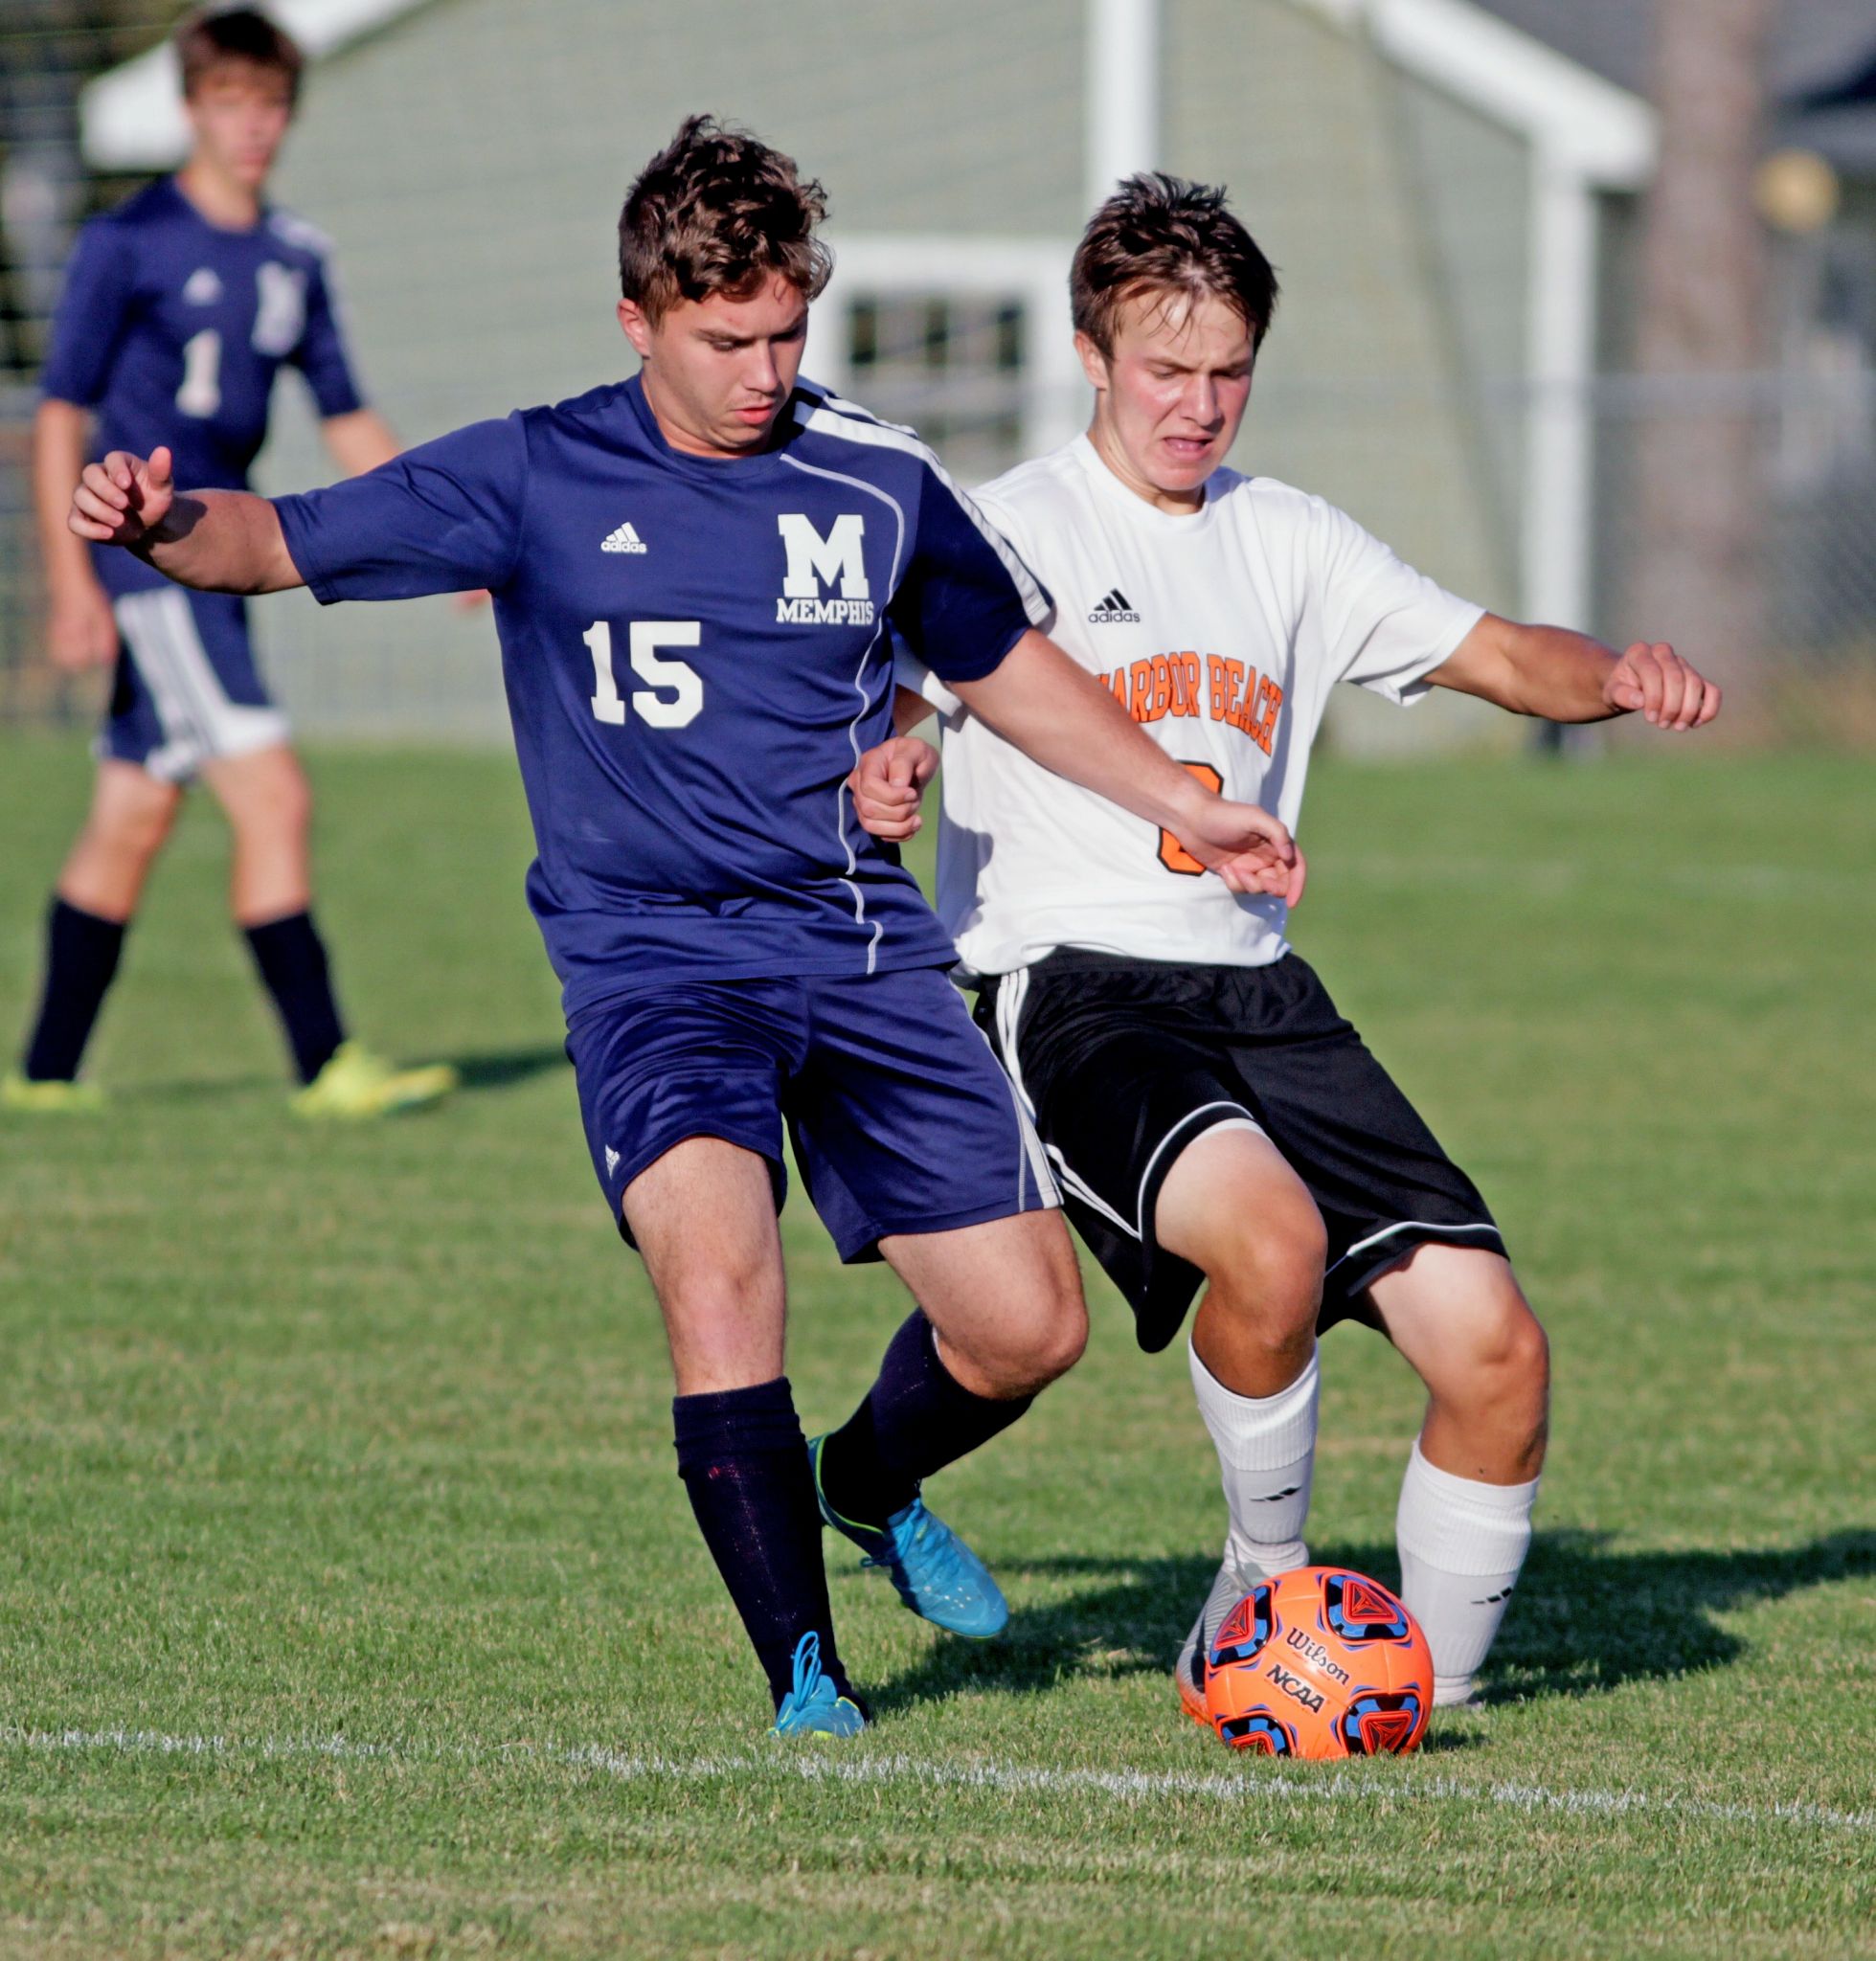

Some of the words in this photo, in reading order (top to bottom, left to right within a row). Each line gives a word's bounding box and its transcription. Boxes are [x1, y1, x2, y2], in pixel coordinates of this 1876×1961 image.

[175, 328, 222, 418] 1
[600, 540, 647, 553] adidas
[778, 513, 870, 598] M
[776, 597, 874, 626] MEMPHIS
[1088, 610, 1141, 623] adidas
[582, 620, 704, 730] 15
[1097, 651, 1201, 724] ARBOR
[1207, 653, 1284, 757] BEACH
[1286, 1627, 1350, 1685] Wilson
[1266, 1663, 1325, 1714] NCAA
